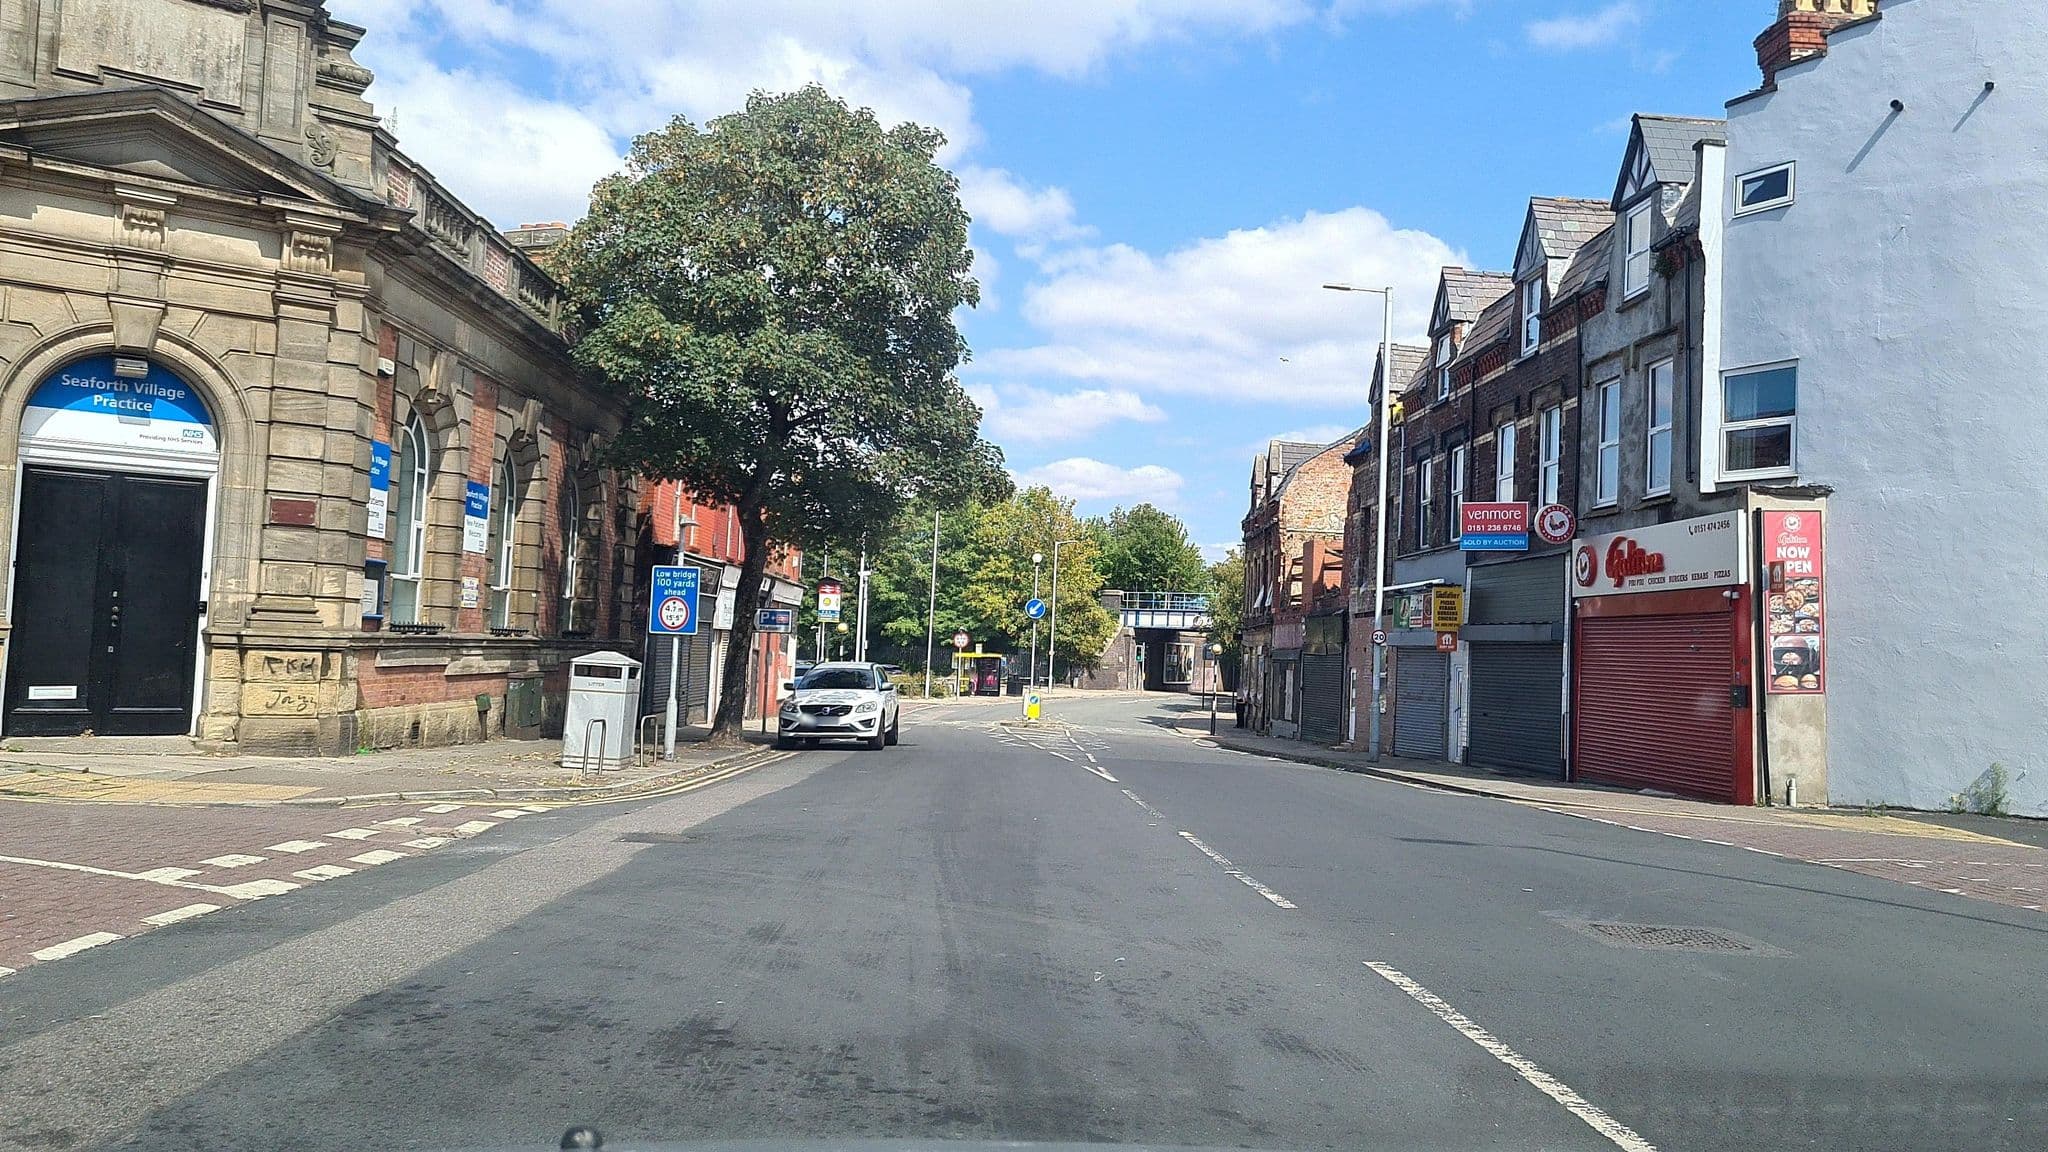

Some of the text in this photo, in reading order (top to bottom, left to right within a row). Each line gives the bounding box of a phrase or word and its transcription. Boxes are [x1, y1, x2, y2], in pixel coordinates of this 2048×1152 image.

[62, 374, 185, 400] Seaforth Village
[93, 394, 153, 412] Practice
[184, 430, 203, 438] NHS
[1467, 510, 1521, 520] venmore
[1776, 546, 1810, 558] NOW
[1785, 561, 1812, 573] PEN
[673, 571, 696, 579] bridge
[1669, 574, 1688, 583] BURGERS
[1691, 572, 1708, 580] KEBABS
[1714, 570, 1730, 578] PIZZAS
[760, 612, 769, 623] P
